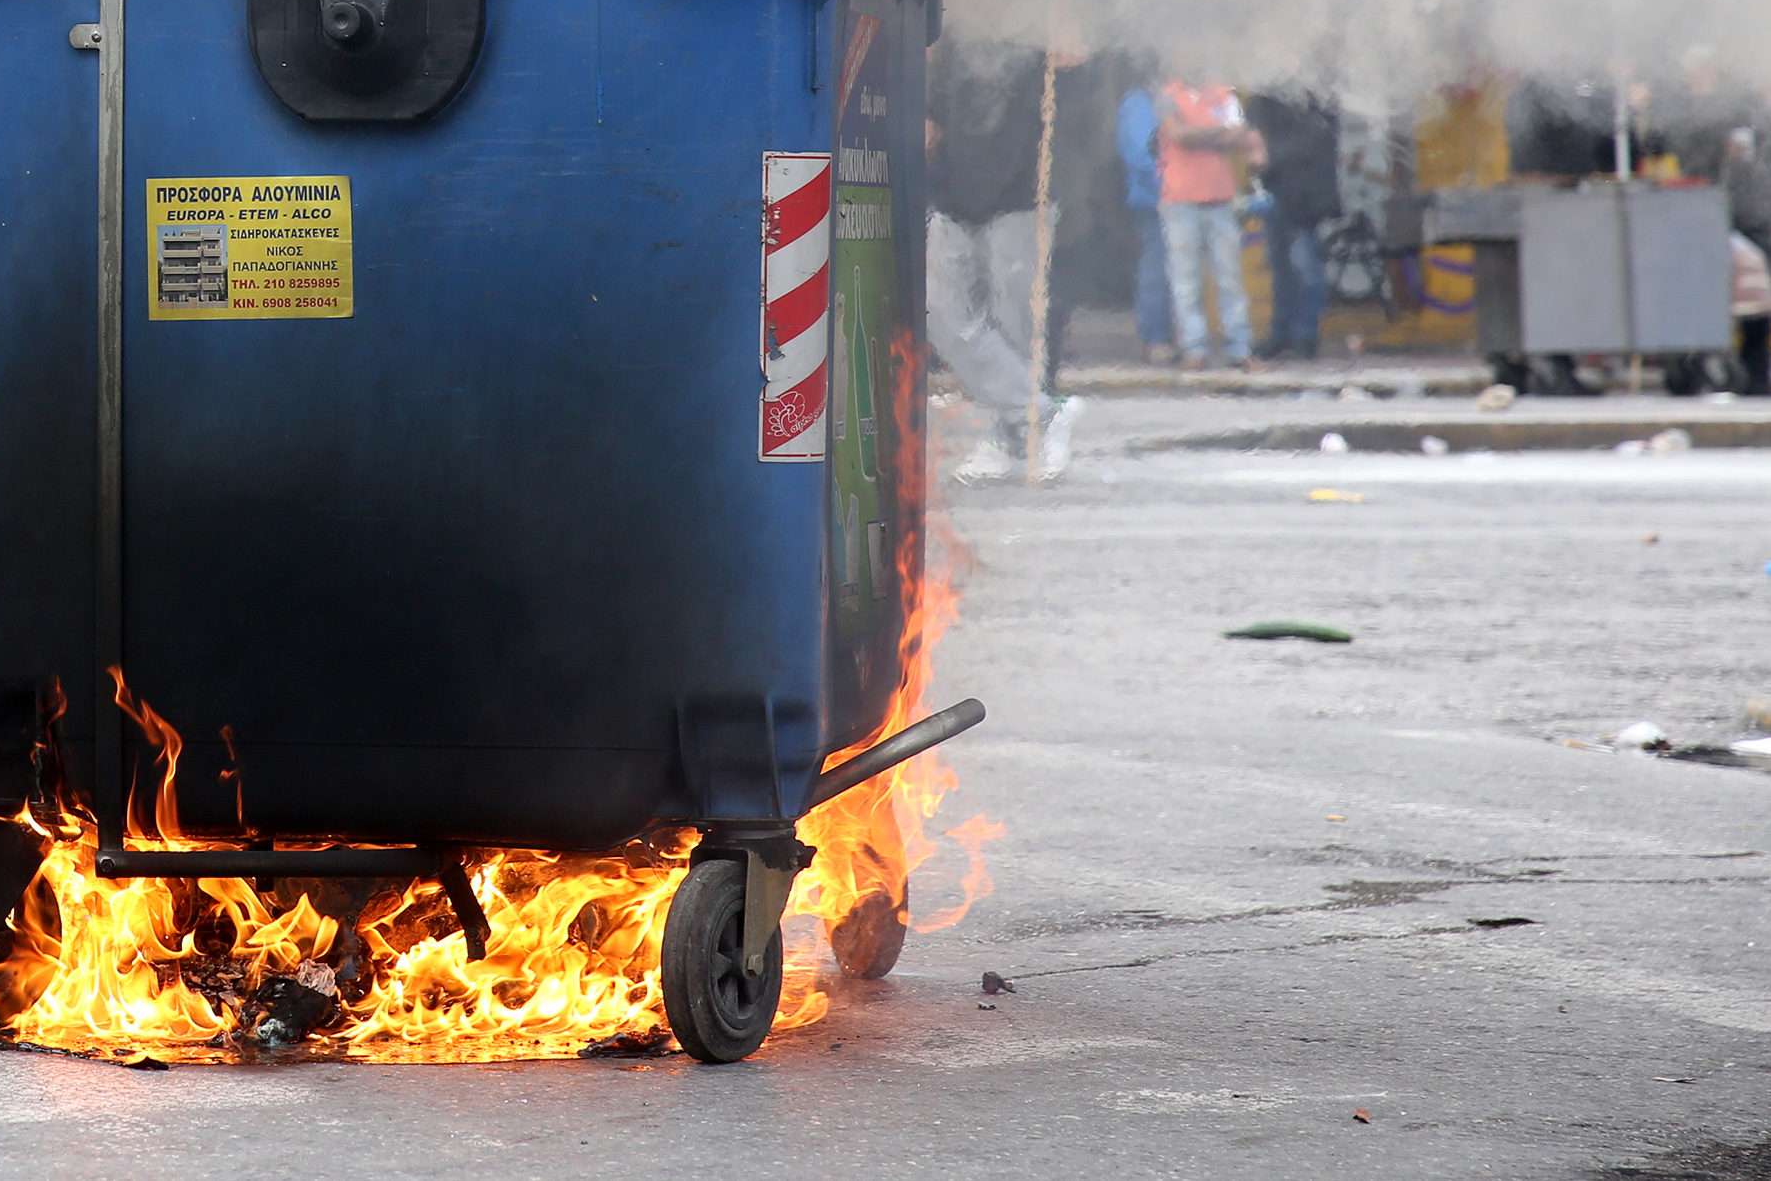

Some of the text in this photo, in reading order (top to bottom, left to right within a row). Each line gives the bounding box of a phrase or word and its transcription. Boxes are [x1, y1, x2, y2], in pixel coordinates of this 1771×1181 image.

[156, 184, 342, 204] ΠΡΟΣΦΟΡΑ ΑΛΟΥΜΙΝΙΑ
[166, 209, 226, 222] EUROPA
[238, 208, 279, 220] ETEM
[291, 208, 332, 220] ALCO
[230, 227, 340, 240] ΣΙΔΗΡΟΚΑΤΑΣΚΕΥΕΣ
[266, 245, 304, 257] ΝΙΚΟΣ
[232, 260, 339, 272] ΠΑΠΑΔΟΓΙΑΝΝΗΣ
[230, 277, 341, 290] ΤΗΛ. 210 8259895
[232, 296, 339, 309] ΚΙΝ. 6908 258041
